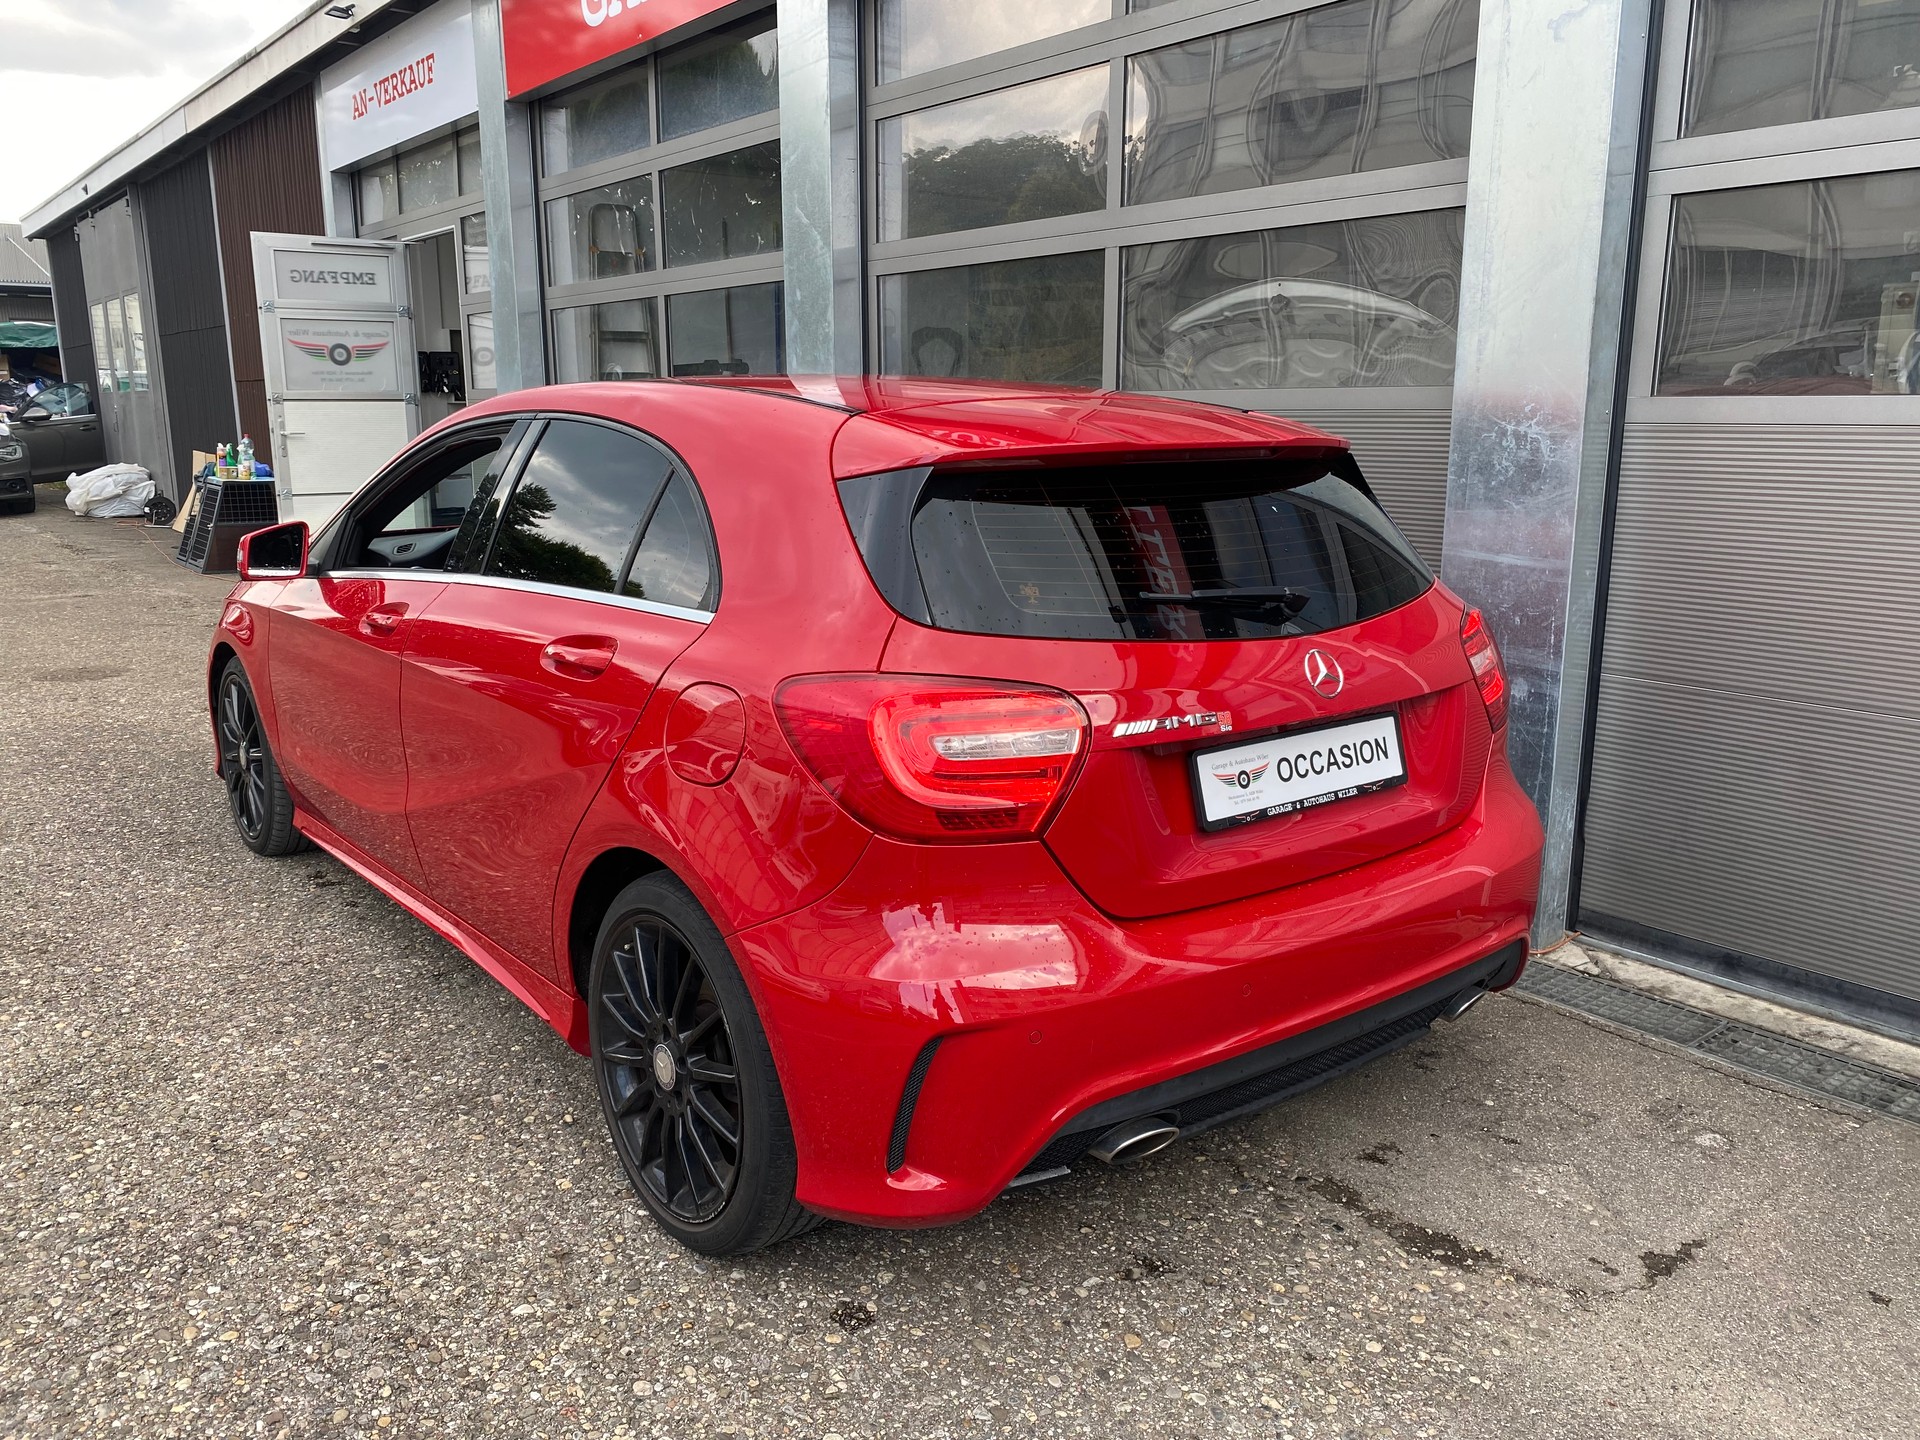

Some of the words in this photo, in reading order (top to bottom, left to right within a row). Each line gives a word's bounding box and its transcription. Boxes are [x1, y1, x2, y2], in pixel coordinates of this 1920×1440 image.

[352, 53, 435, 120] AN-VERKAUF
[1211, 762, 1228, 771] Garage
[1235, 757, 1256, 766] Autohaus
[1277, 736, 1389, 783] OCCASION
[1267, 803, 1293, 815] GARAGE
[1303, 793, 1336, 807] AUTOHAUS
[1337, 788, 1358, 799] WILER
